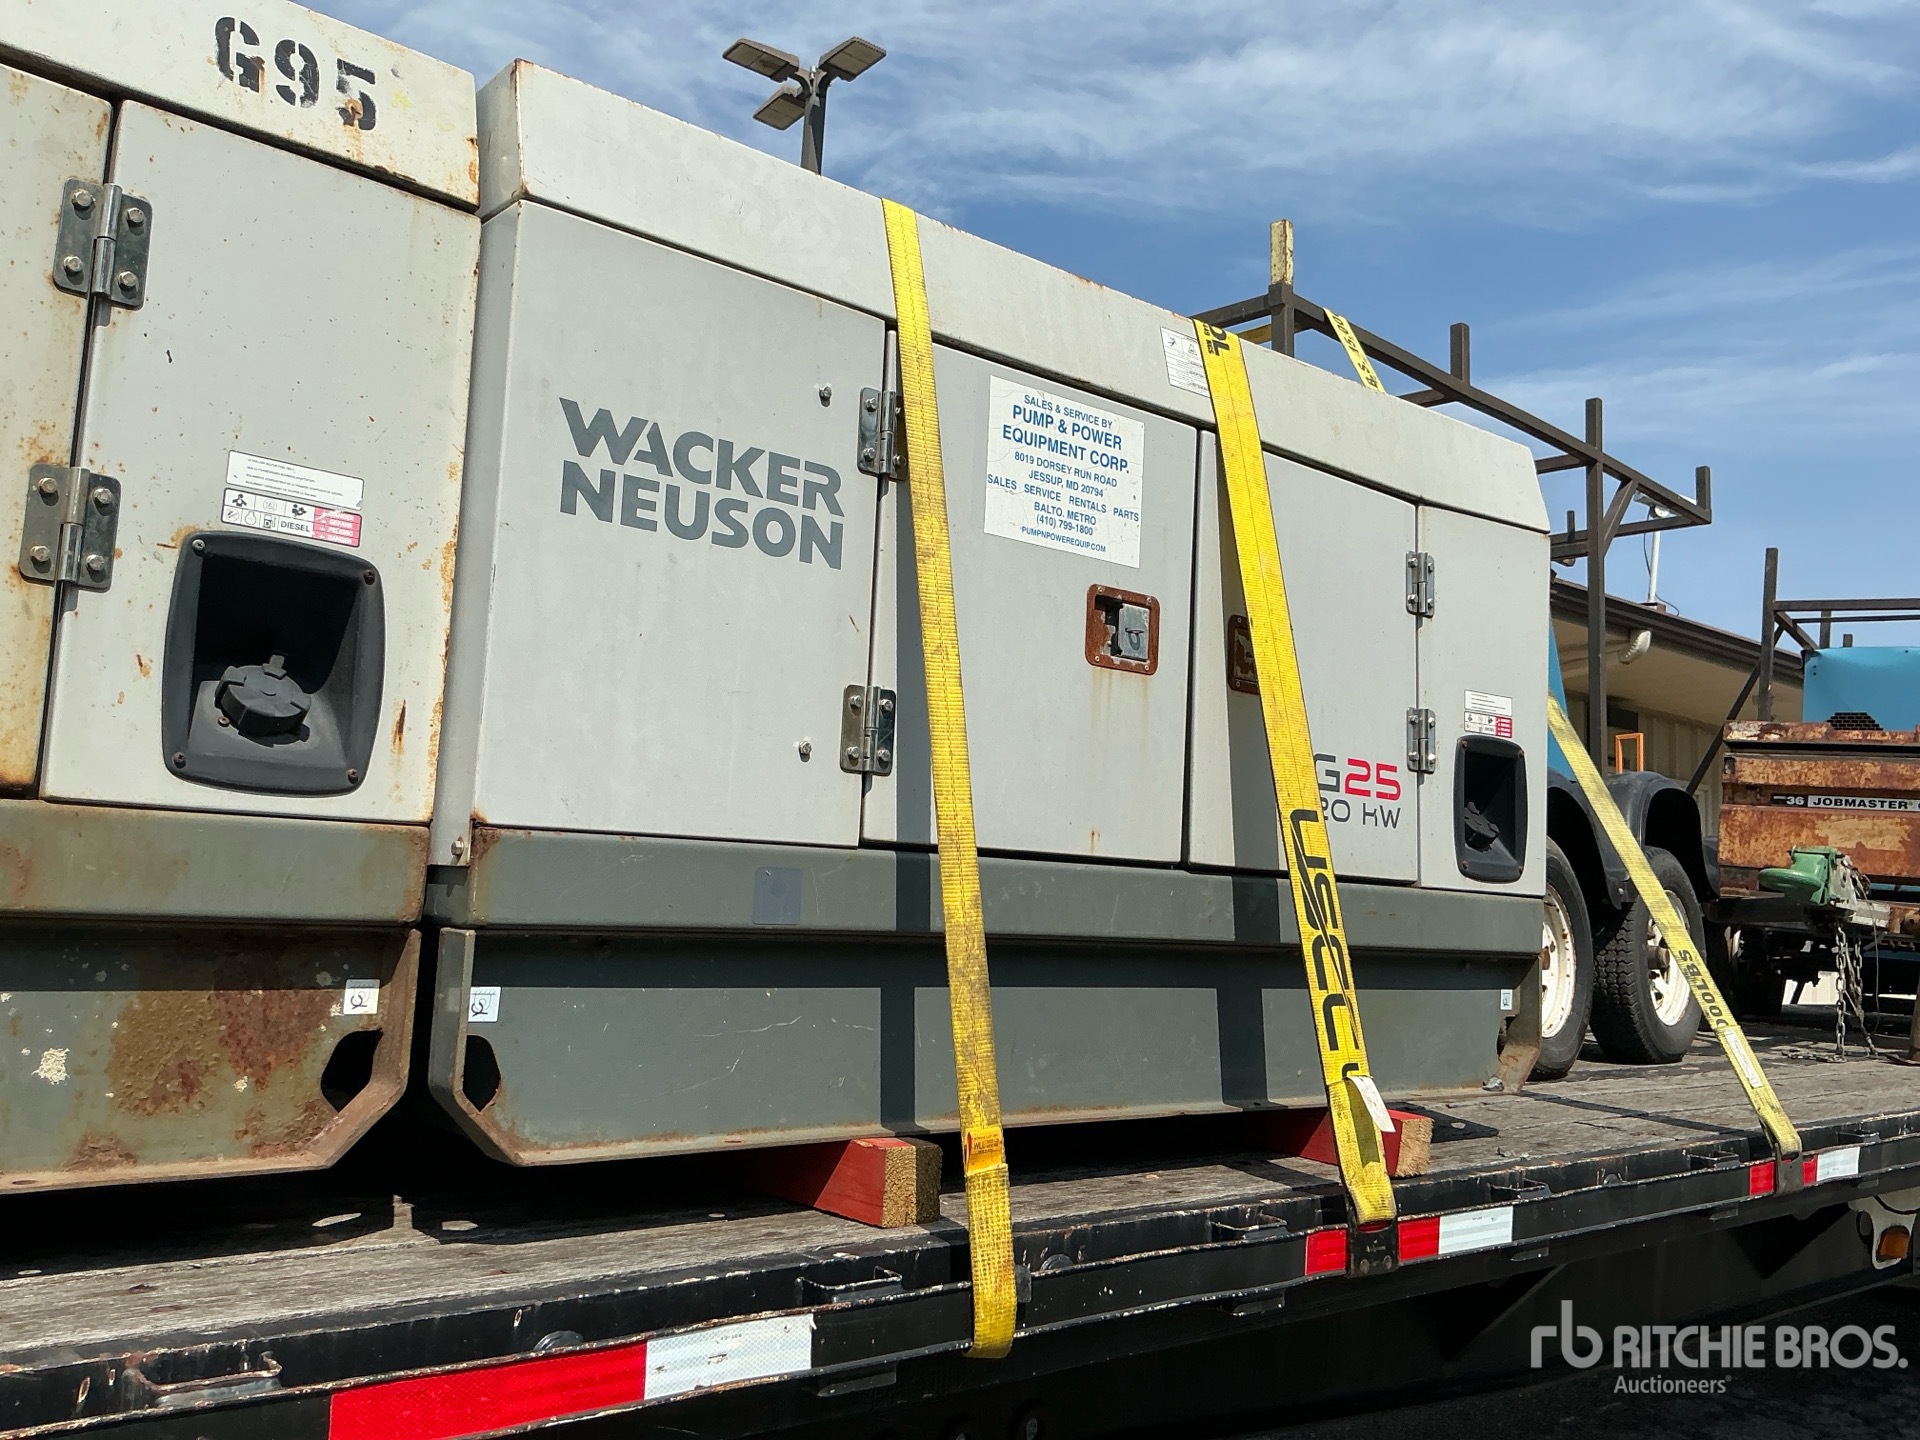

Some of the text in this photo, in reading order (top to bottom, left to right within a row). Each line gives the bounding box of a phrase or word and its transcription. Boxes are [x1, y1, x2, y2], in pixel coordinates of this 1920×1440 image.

[215, 16, 376, 131] G95
[1013, 405, 1122, 450] PUMP & POWER
[1024, 394, 1113, 428] SALES & SERVICE BY
[558, 397, 845, 517] WACKER
[1003, 424, 1129, 473] EQUIPMENT CORP.
[1014, 451, 1117, 487] 8019 DORSEY RUN ROAD
[1029, 470, 1103, 497] JESSUP, MD 20794
[560, 460, 844, 570] NEUSON
[988, 474, 1139, 521] SALES SERVICE RENTALS PARTS
[1034, 502, 1096, 525] BALTO. METRO
[280, 520, 311, 533] DIESEL
[1021, 526, 1106, 552] PUMPNPOWEREQUIP.COM
[1037, 514, 1093, 535] (410) 799-1800
[1314, 753, 1401, 801] G25
[1786, 796, 1805, 805] 36
[1813, 797, 1908, 809] JOBMASTER
